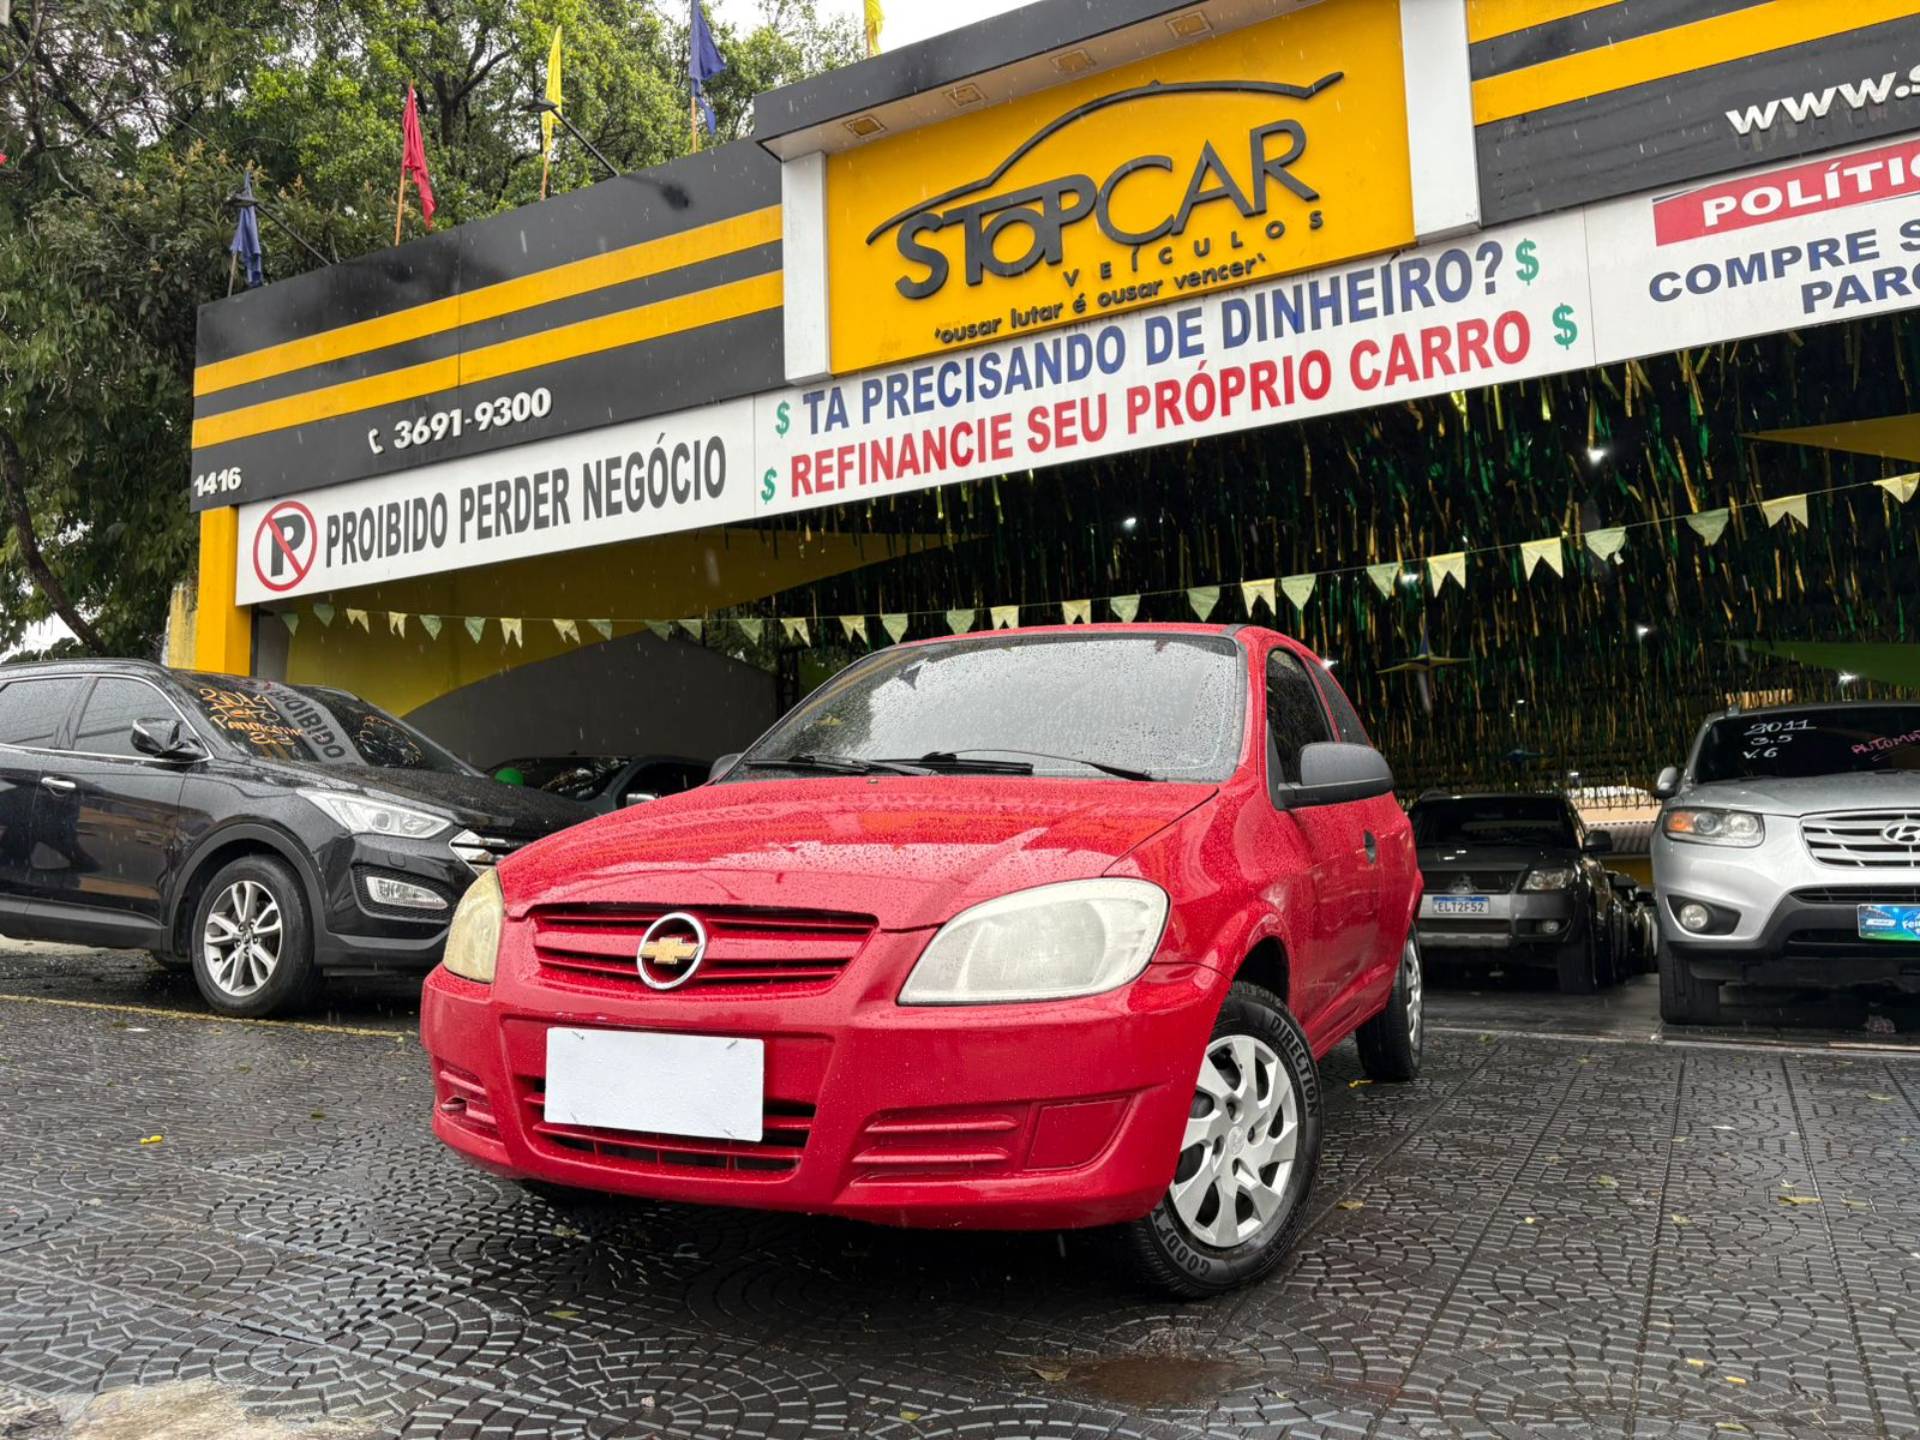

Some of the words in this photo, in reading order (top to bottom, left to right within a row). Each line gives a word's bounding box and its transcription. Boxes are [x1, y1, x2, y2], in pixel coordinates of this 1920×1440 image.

[895, 118, 1320, 300] STOPCAR
[1703, 154, 1920, 227] POLÍTI
[1063, 210, 1325, 288] VEÍCULOS
[1649, 228, 1881, 302] COMPRE
[1010, 298, 1064, 329] lutar
[1073, 293, 1087, 313] é
[1097, 279, 1163, 308] ousar
[1801, 265, 1920, 315] PAR
[790, 414, 1014, 499] REFINANCIE
[1027, 393, 1109, 454] SEU
[1126, 349, 1332, 435] PRÓPRIO
[1349, 310, 1531, 391] CARRO
[802, 391, 850, 437] TA
[862, 325, 1126, 426] PRECISANDO
[1145, 303, 1205, 366] DE
[393, 387, 553, 450] 3691-9300
[193, 466, 242, 497] 1416
[326, 493, 448, 569] PROIBIDO
[460, 467, 570, 544] PERDER
[583, 432, 727, 521] NEGÓCIO
[1743, 719, 1817, 736] 2011
[1750, 734, 1793, 746] 3.5
